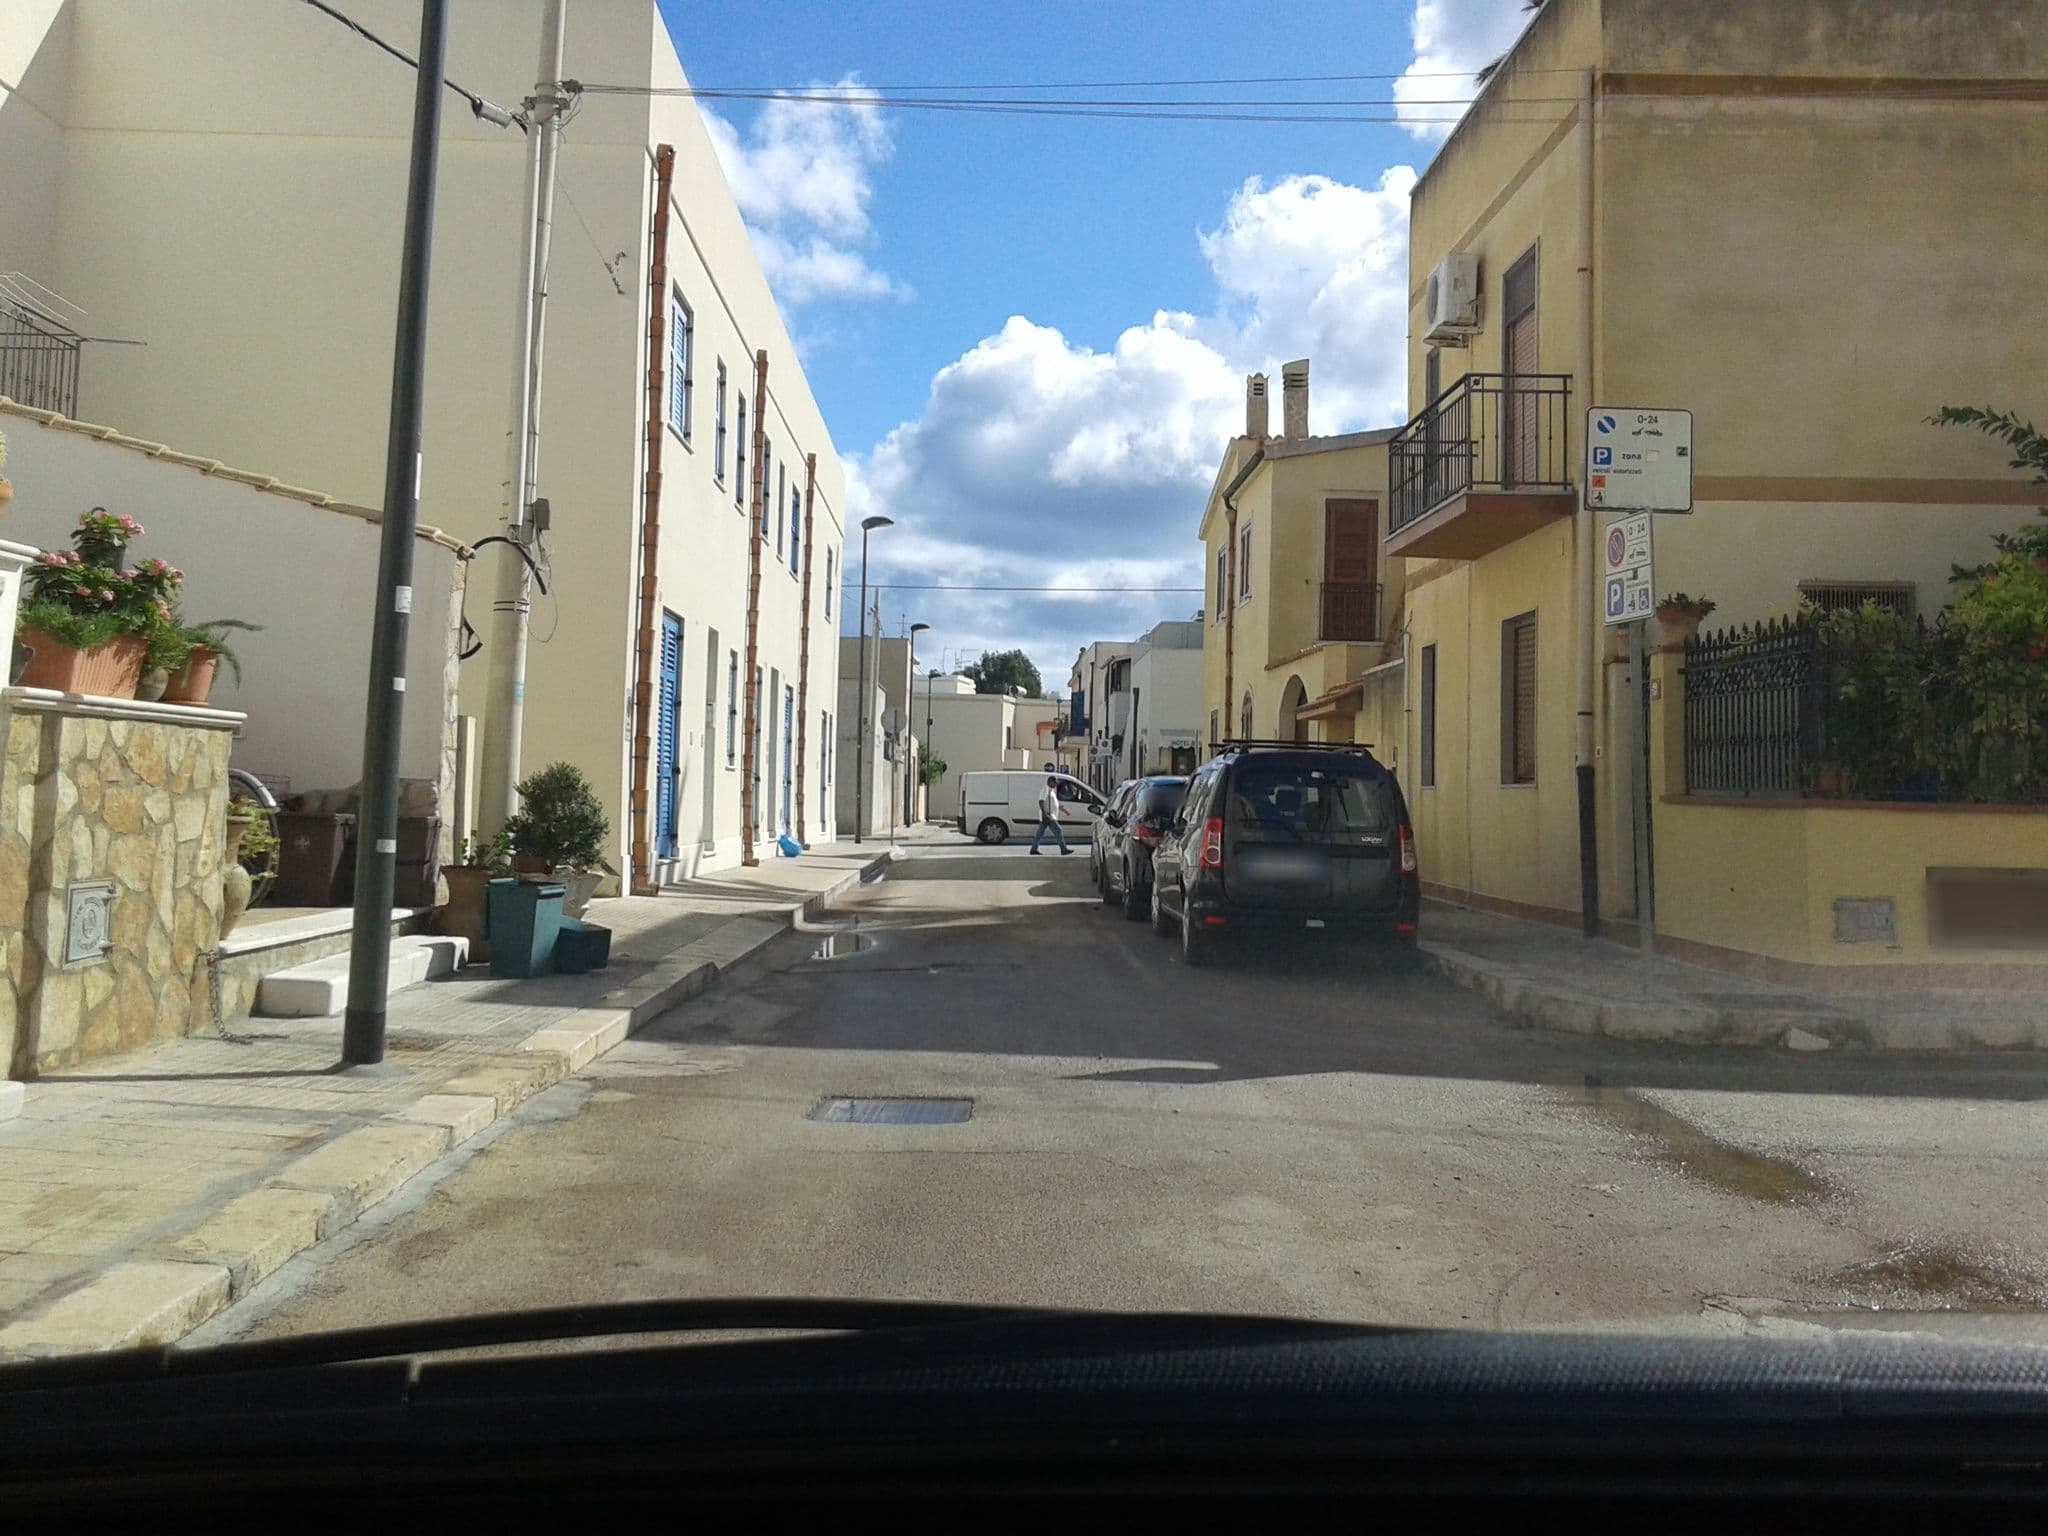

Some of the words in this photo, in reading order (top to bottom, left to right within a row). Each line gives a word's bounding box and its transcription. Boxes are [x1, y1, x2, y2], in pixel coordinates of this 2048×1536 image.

[1637, 414, 1658, 424] 0-24
[1596, 448, 1608, 464] P
[1611, 583, 1620, 612] P
